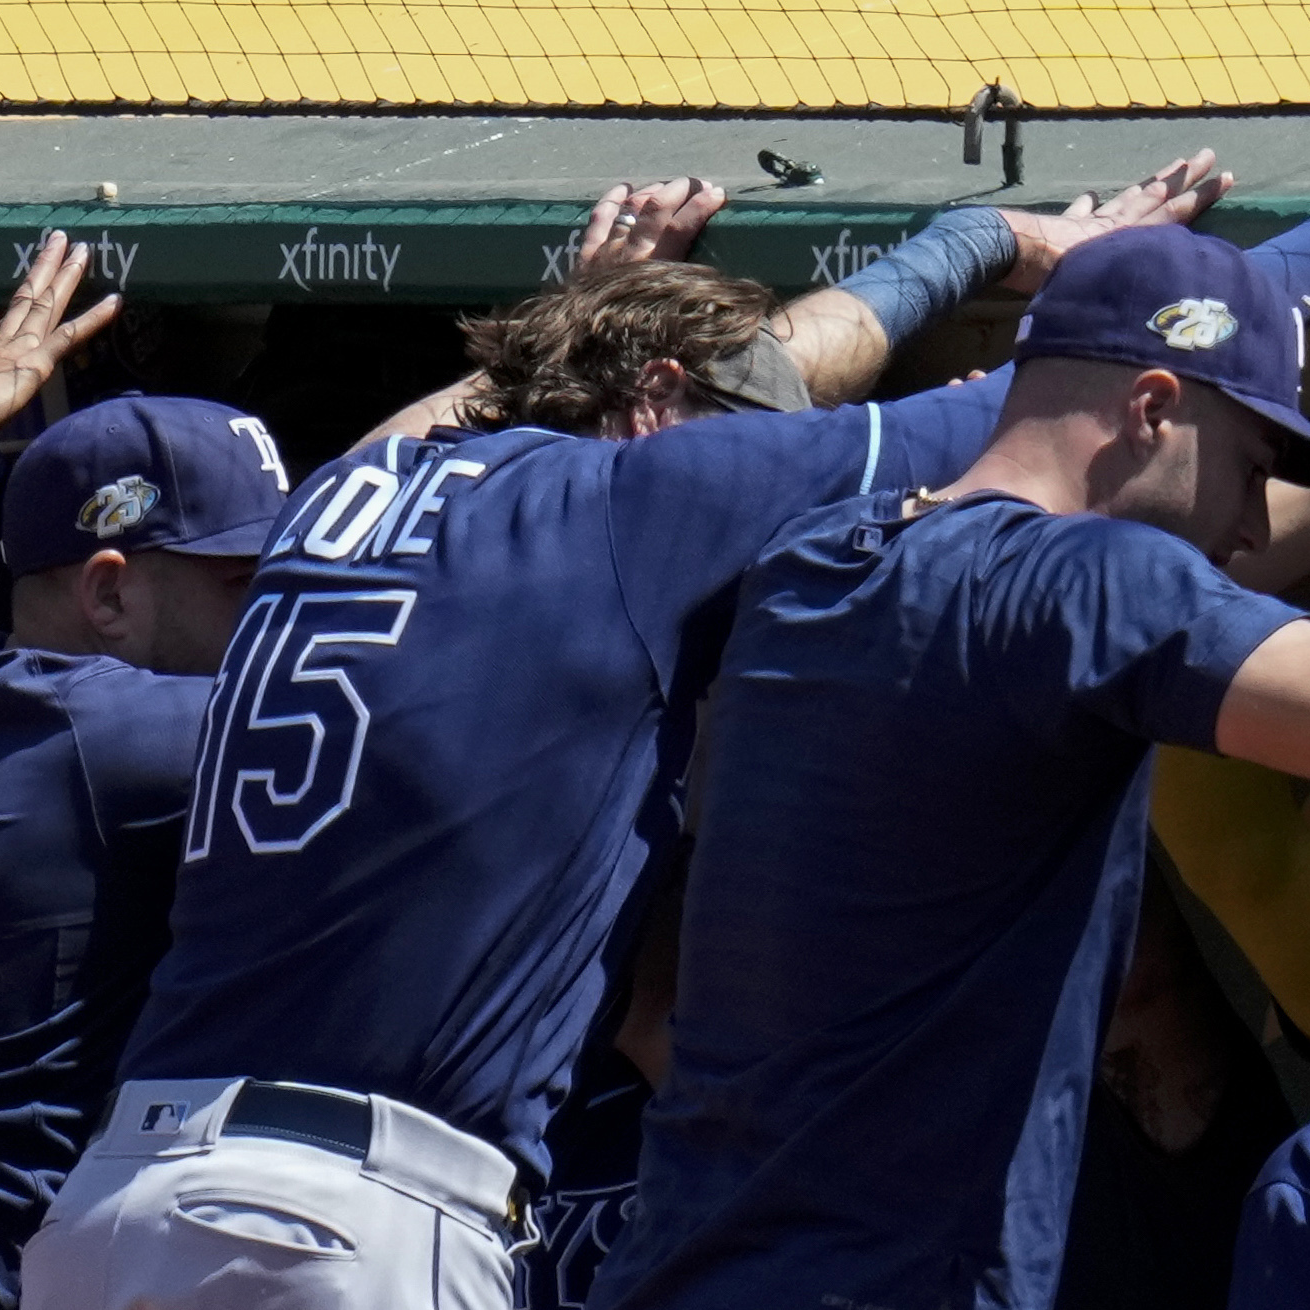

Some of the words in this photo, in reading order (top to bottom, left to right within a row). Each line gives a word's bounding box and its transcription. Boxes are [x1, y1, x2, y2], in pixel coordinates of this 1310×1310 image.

[11, 226, 139, 292] xity
[278, 226, 402, 292] xfinity
[184, 589, 418, 864] 15
